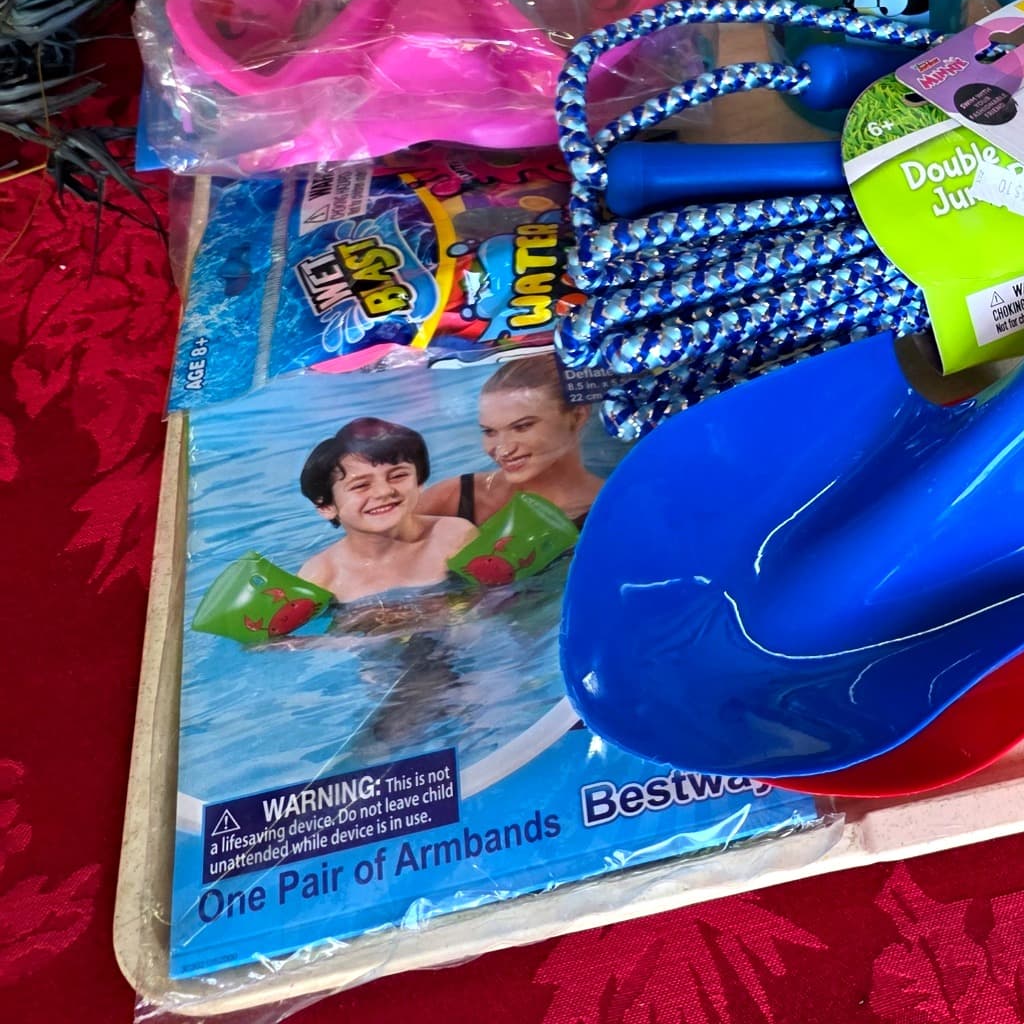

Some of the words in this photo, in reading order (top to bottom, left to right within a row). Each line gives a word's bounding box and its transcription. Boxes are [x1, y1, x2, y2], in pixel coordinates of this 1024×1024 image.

[867, 120, 894, 137] 6+
[900, 142, 1000, 190] Double
[932, 186, 977, 216] Ju
[300, 252, 353, 311] WET
[338, 239, 409, 316] BLAST
[510, 223, 559, 327] WATER
[191, 337, 209, 357] 8+
[995, 321, 1008, 334] Not
[1008, 316, 1018, 330] for
[186, 360, 206, 389] AGE
[570, 394, 584, 402] 22
[210, 842, 218, 855] a
[221, 827, 285, 853] lifesaving
[288, 814, 335, 836] device.
[338, 807, 357, 824] Do
[359, 800, 382, 819] not
[385, 792, 419, 812] leave
[422, 783, 454, 804] child
[262, 775, 381, 822] WARNING:
[385, 775, 412, 794] This
[415, 772, 426, 787] is
[428, 766, 450, 784] not
[580, 769, 774, 826] Bestwa
[198, 883, 266, 923] One
[279, 862, 344, 905] Pair
[353, 847, 387, 885] of
[394, 811, 561, 877] Armbands
[209, 847, 289, 875] unattended
[291, 833, 328, 854] while
[331, 823, 374, 846] device
[376, 817, 387, 834] is
[390, 814, 402, 830] in
[405, 810, 432, 827] use.
